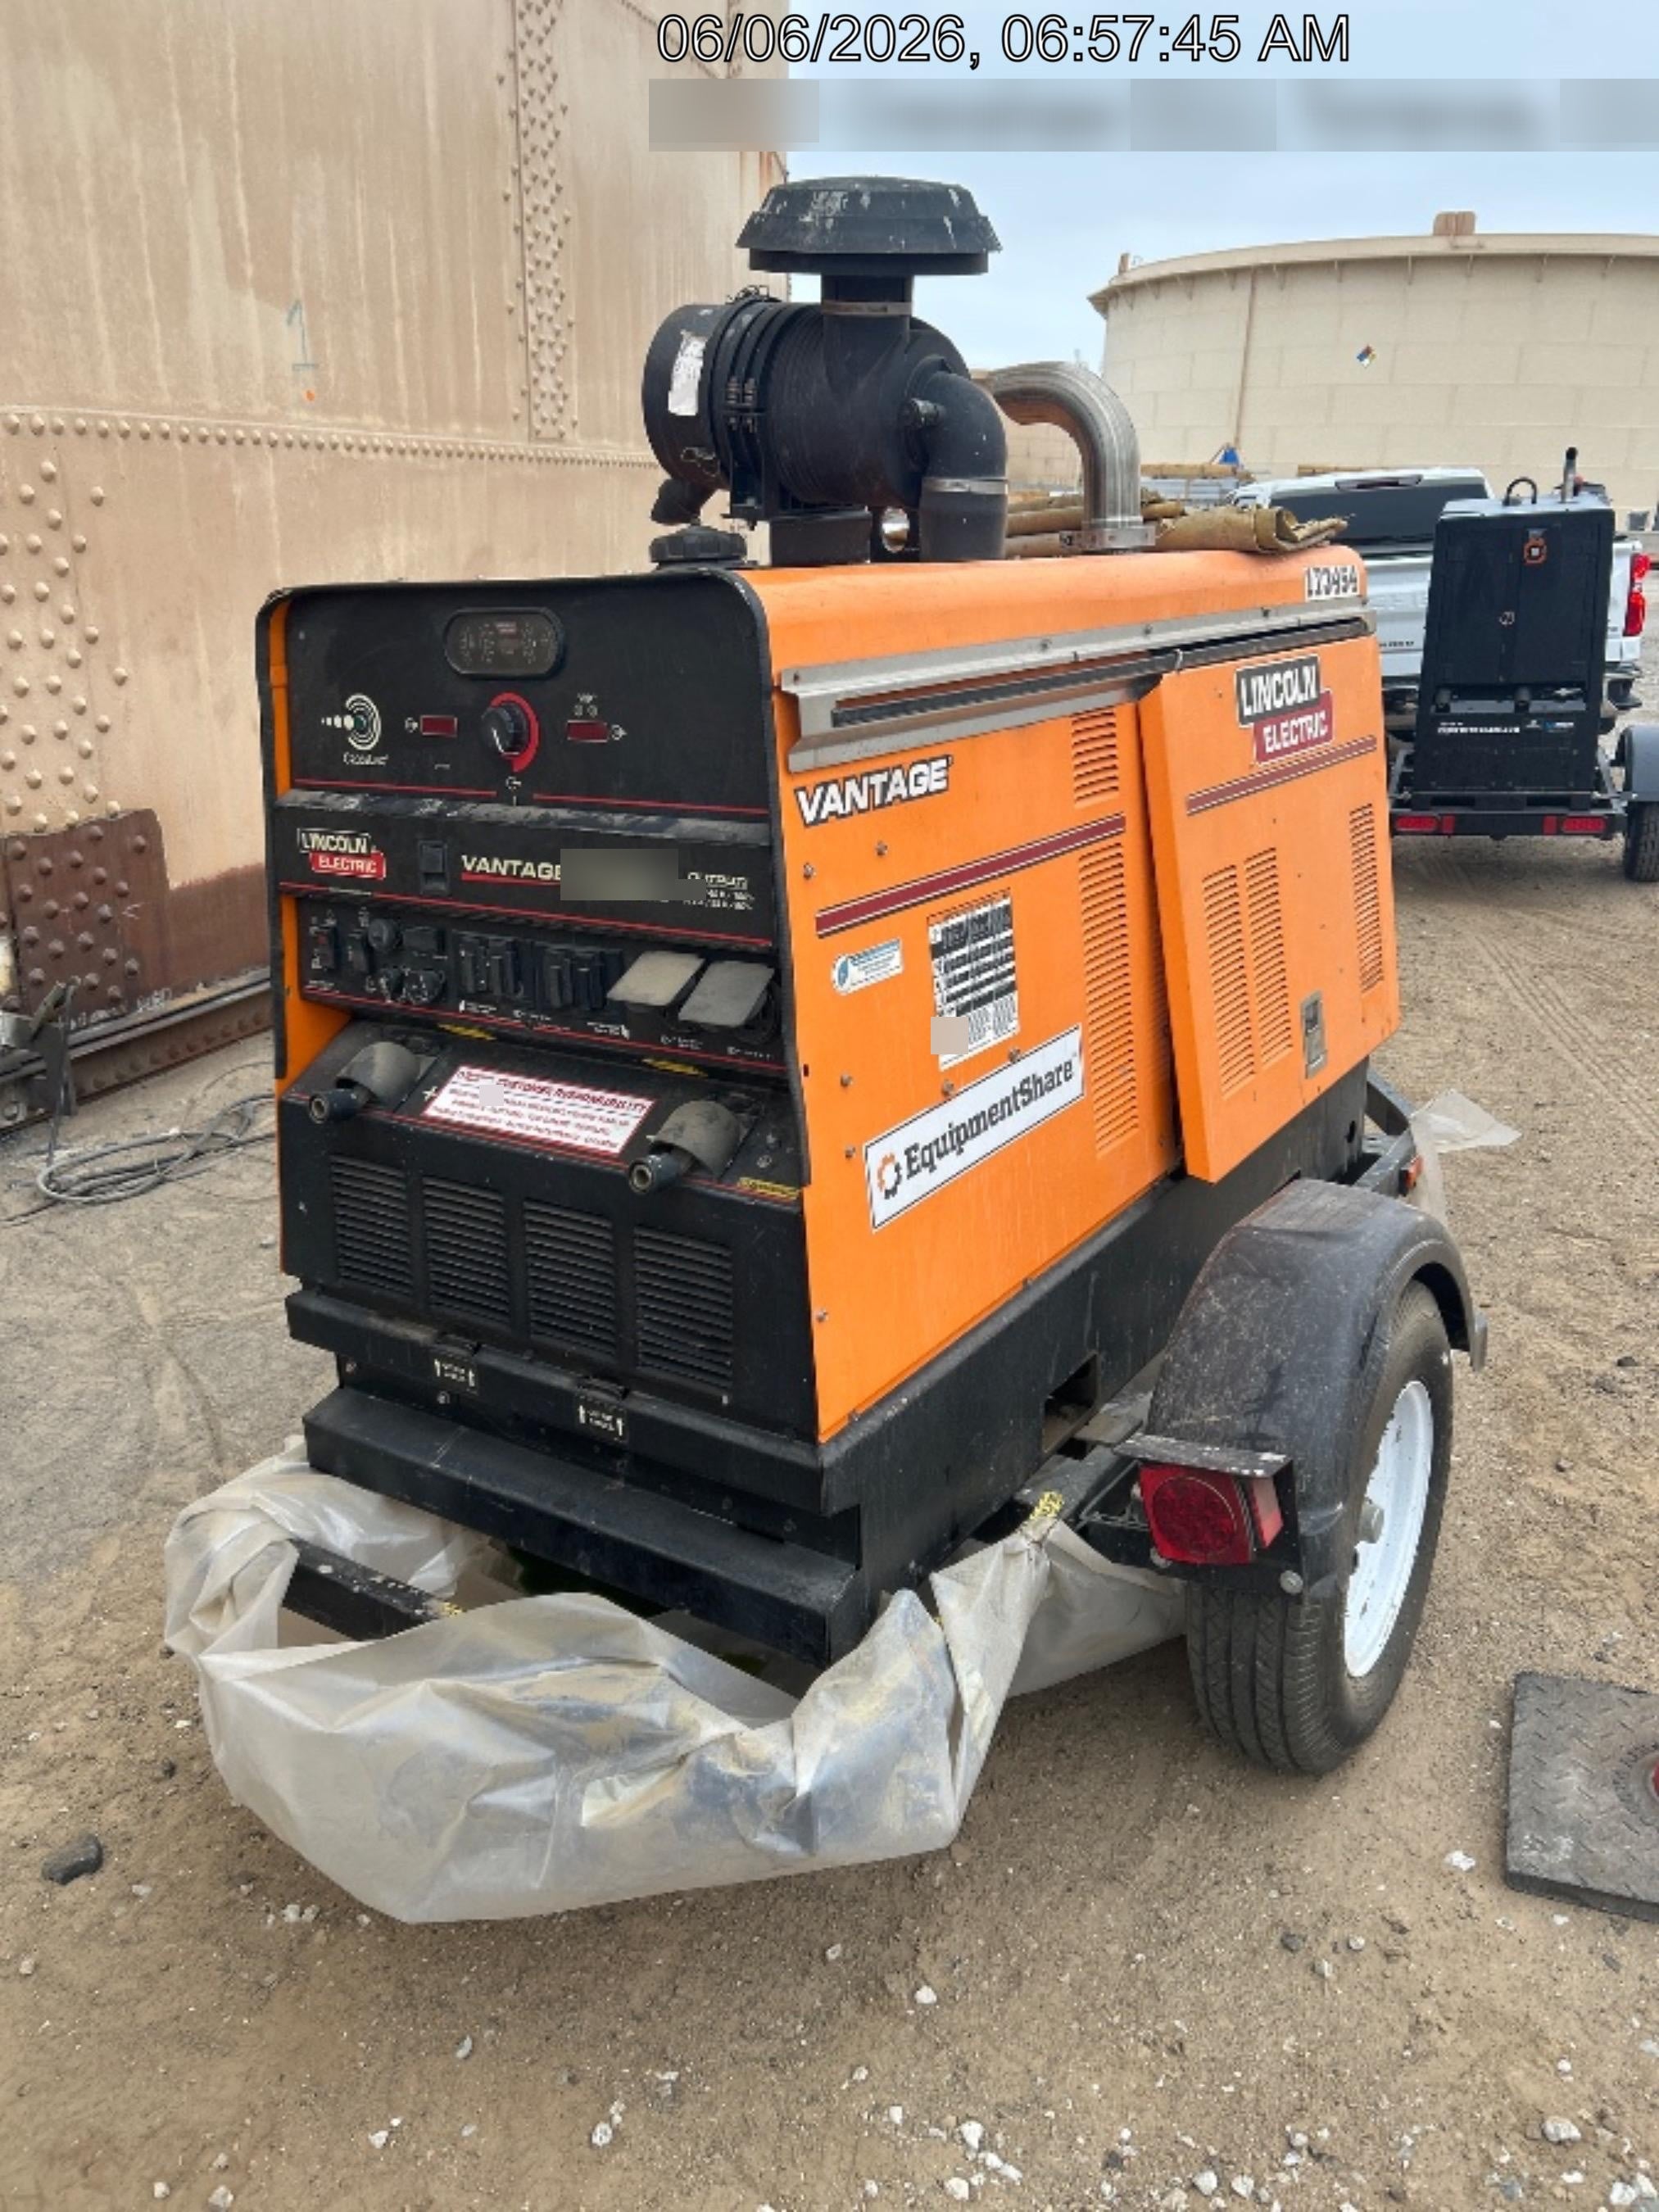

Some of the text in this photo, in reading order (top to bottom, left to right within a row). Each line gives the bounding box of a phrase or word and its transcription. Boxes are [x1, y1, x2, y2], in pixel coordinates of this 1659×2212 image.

[1240, 664, 1318, 717] LINCOLN
[1262, 710, 1328, 754] ELECTRIC
[796, 759, 948, 825] VANTAGE
[301, 833, 368, 854] LINCOLN
[318, 855, 378, 874] ELECTRIC
[904, 1059, 1073, 1180] EquipmentShare
